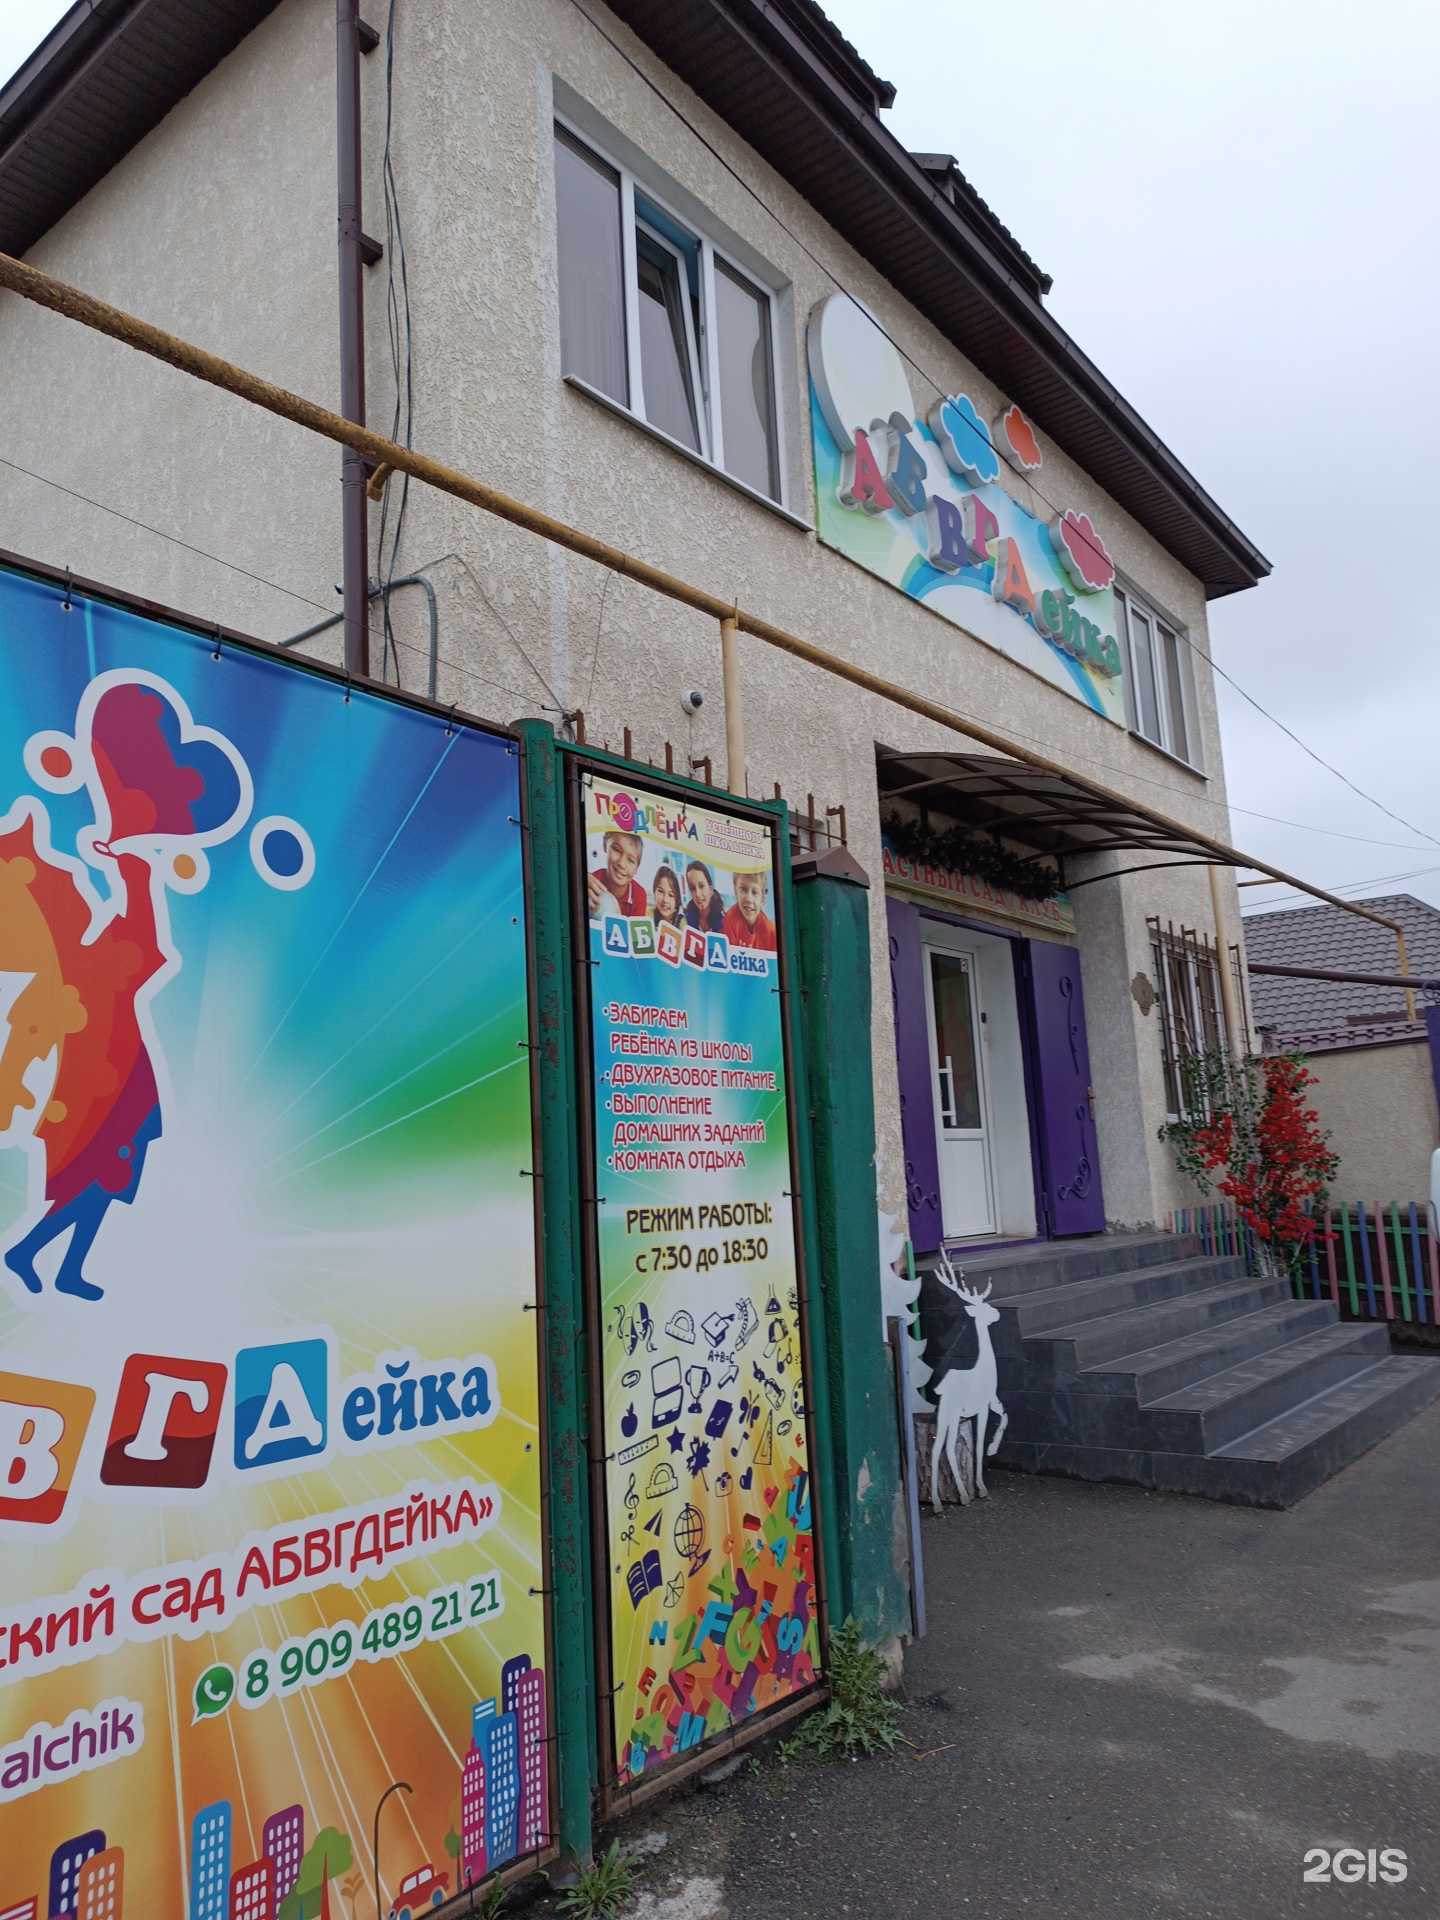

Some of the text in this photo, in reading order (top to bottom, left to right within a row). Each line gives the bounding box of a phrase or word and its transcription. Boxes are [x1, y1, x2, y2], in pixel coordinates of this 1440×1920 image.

[610, 1003, 688, 1028] ЗАБИРАЕМ
[611, 1032, 752, 1062] РЕБЁНКА ИЗ ШКОЛЫ
[611, 1063, 775, 1089] ДВУХРАЗОВОЕ ПИТАНИЕ
[613, 1094, 711, 1115] ВЫПОЛНЕНИЕ
[614, 1120, 766, 1146] ДОМАШНИХ ЗАДАНИЙ
[615, 1151, 746, 1172] КОМНАТА ОТДЫХА
[626, 1202, 773, 1234] РЕЖИМ РАБОТЫ:
[652, 1245, 692, 1271] 7:30
[696, 1248, 719, 1273] до
[722, 1238, 768, 1264] 18:30
[131, 1566, 225, 1627] сад
[245, 1579, 500, 1699] 8 909 489 21 21
